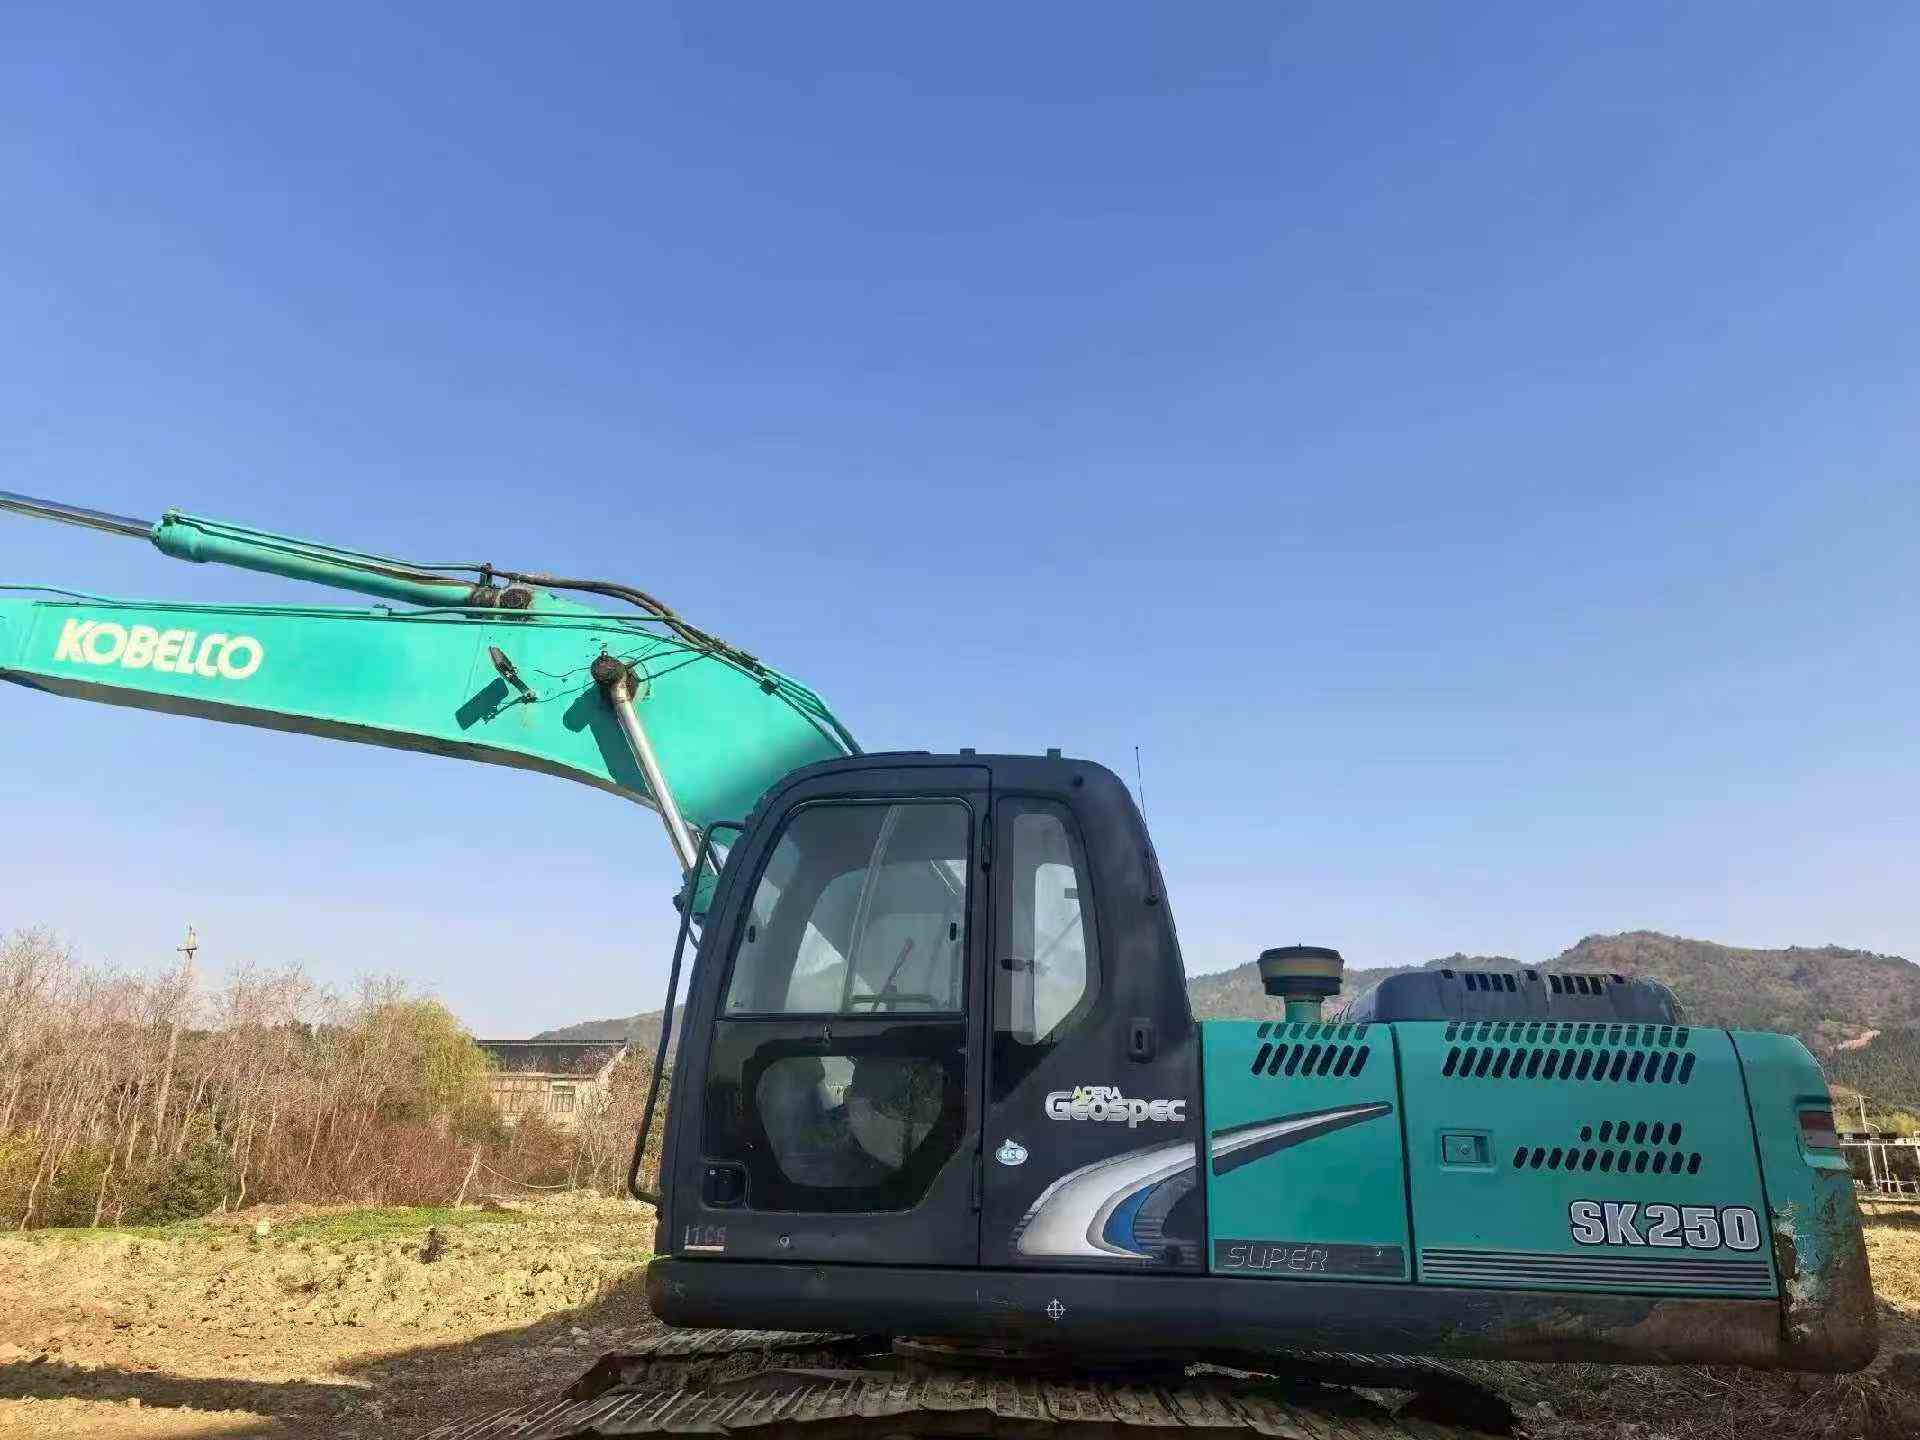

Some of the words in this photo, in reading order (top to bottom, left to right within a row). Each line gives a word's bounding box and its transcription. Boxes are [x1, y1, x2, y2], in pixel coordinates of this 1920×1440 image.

[54, 618, 264, 679] KOBELCO
[1569, 1200, 1761, 1250] SK250
[1224, 1246, 1328, 1271] SUPER
